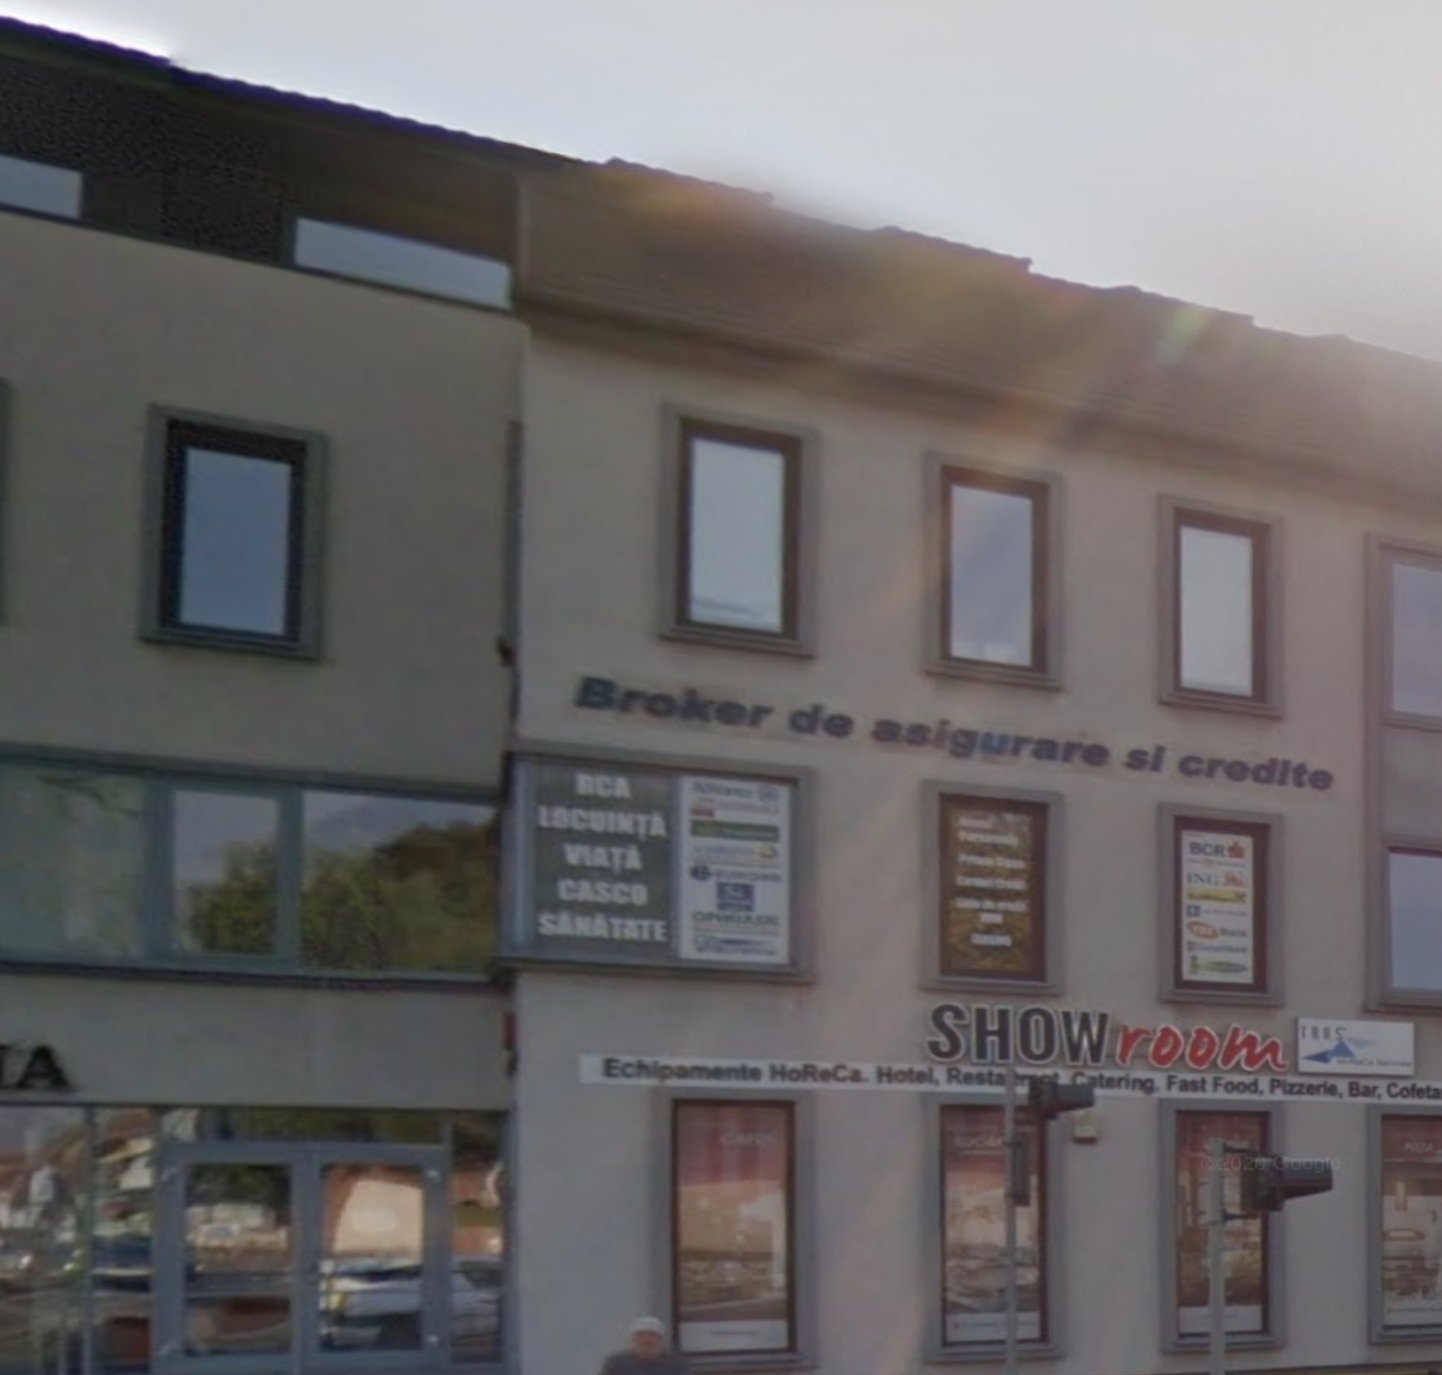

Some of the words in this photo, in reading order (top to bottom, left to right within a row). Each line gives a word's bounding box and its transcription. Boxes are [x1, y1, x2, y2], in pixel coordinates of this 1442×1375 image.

[574, 675, 774, 729] Broker
[789, 704, 853, 738] de
[871, 718, 1110, 767] asigurare
[1123, 744, 1165, 772] si
[1178, 754, 1333, 791] credite
[1189, 841, 1225, 857] BCR
[557, 878, 648, 906] CASCO
[1187, 872, 1219, 887] ING
[603, 1057, 762, 1083] Echipamente
[876, 1065, 940, 1087] Hotel,
[946, 1067, 1060, 1088] Restart
[1166, 1075, 1208, 1093] Fast
[1212, 1077, 1265, 1096] Food,
[1270, 1078, 1343, 1099] Pizzerie,
[1349, 1081, 1382, 1100] Bar,
